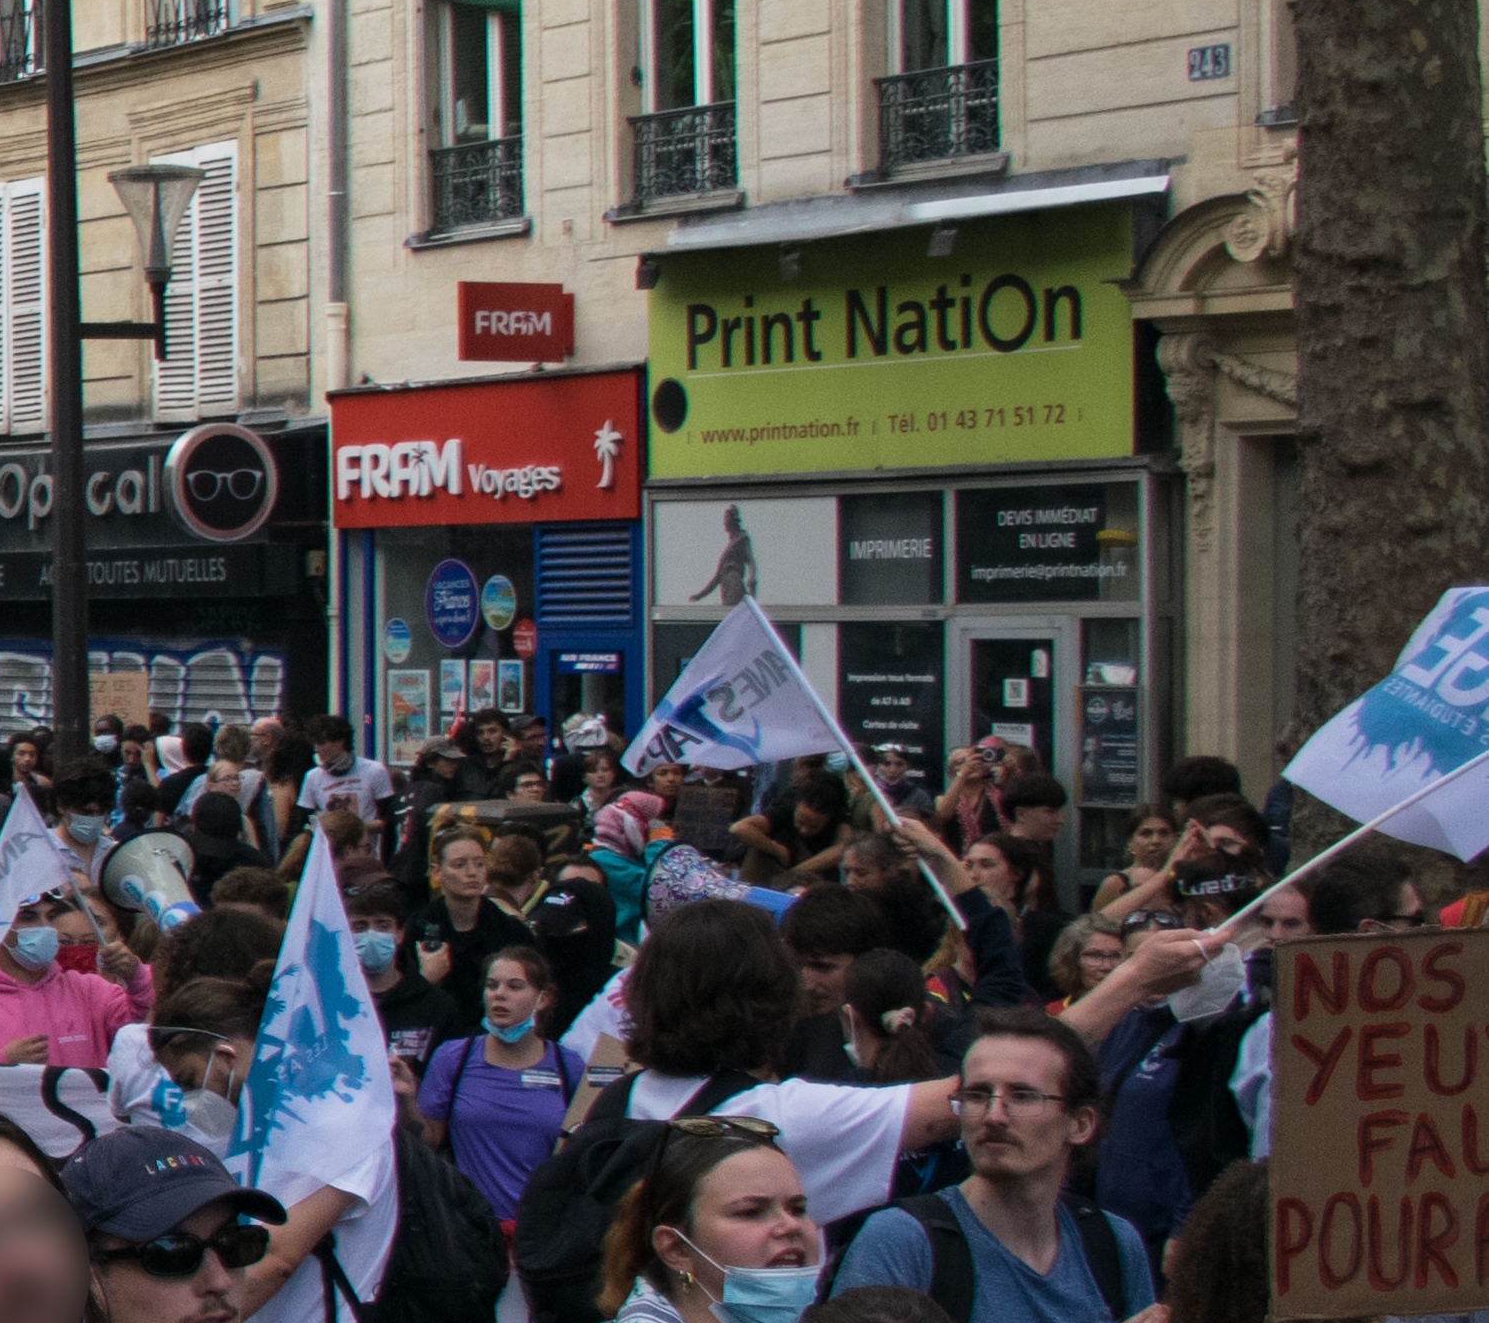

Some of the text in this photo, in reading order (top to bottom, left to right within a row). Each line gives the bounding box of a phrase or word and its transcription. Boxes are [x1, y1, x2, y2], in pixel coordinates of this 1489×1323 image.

[474, 311, 551, 336] FRAM
[686, 274, 1083, 370] Print NatiOn
[701, 404, 1066, 445] www.printnation.fr Tél. 01 43 71 51 72
[336, 438, 562, 500] FRAM Voyages
[998, 509, 1033, 526] DEVIS
[850, 539, 932, 560] IMPRIMERIE
[1019, 532, 1076, 548] EN LIGNE
[86, 558, 227, 584] TOUTES MUTUELLES
[1293, 941, 1466, 1023] NOS
[1290, 1021, 1489, 1106] YEU
[1276, 1192, 1461, 1297] POUR
